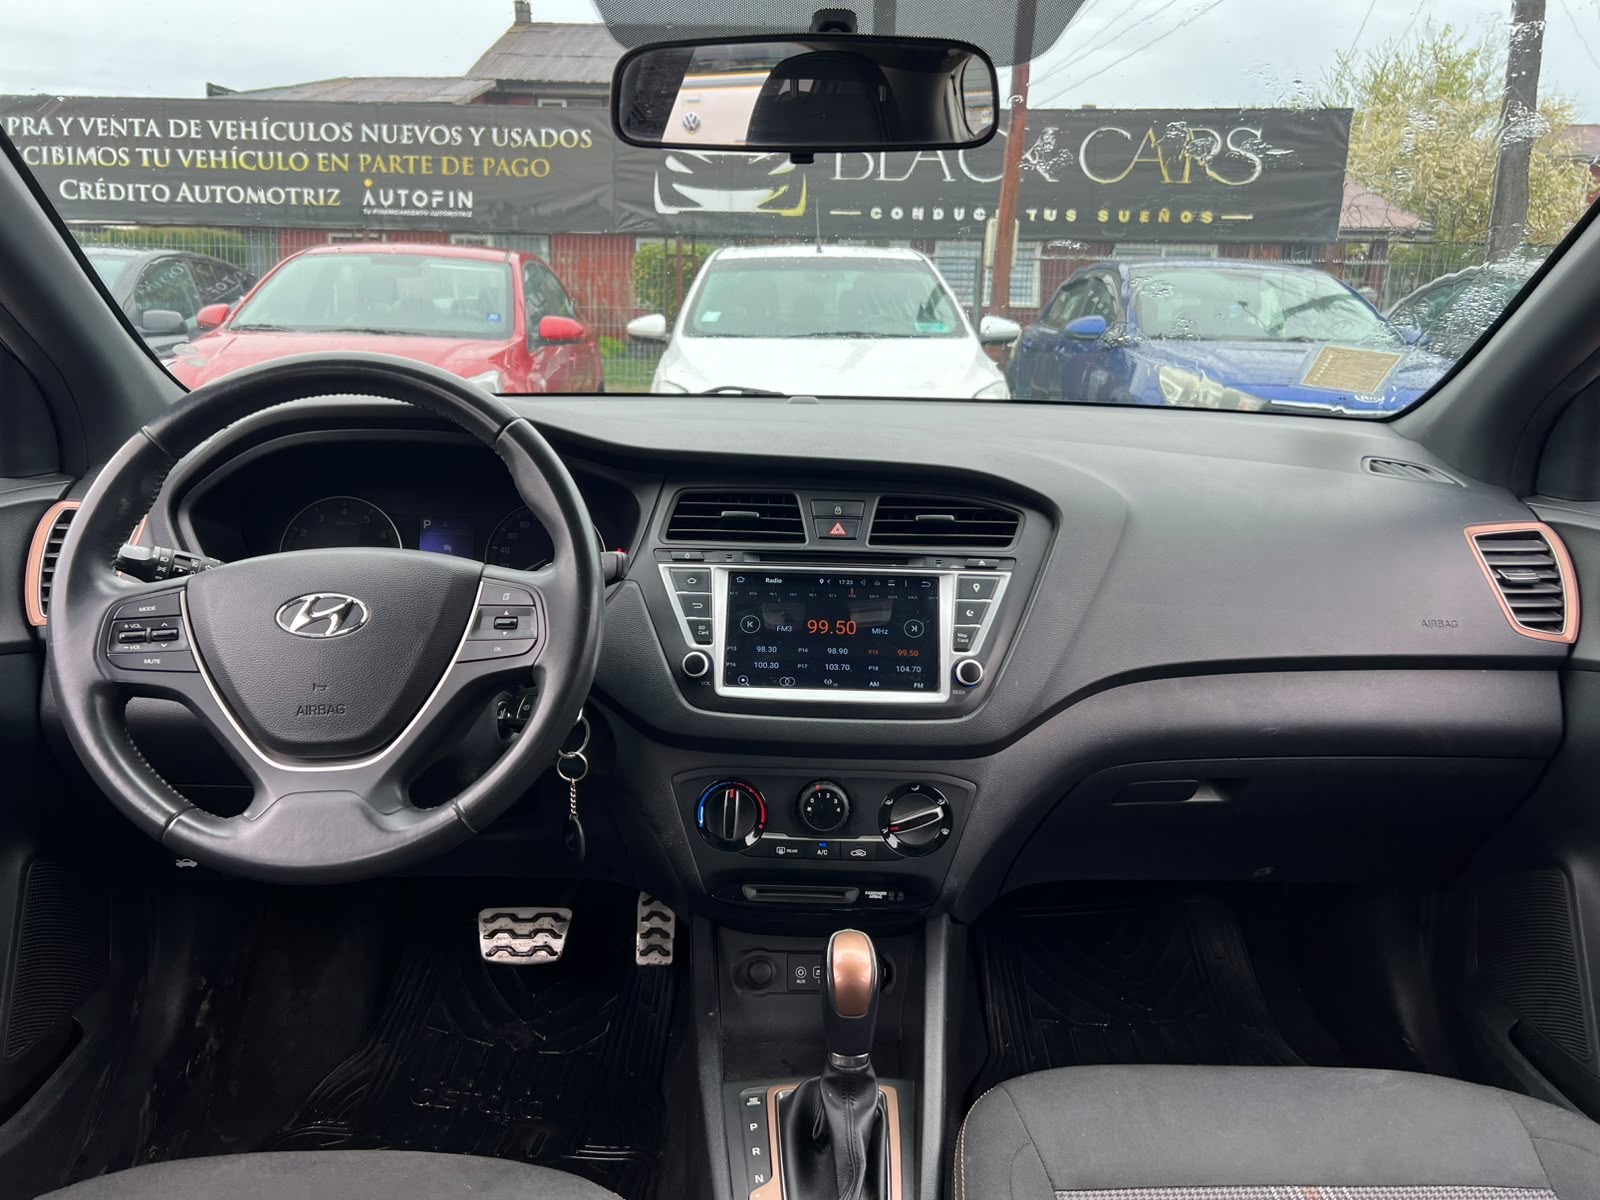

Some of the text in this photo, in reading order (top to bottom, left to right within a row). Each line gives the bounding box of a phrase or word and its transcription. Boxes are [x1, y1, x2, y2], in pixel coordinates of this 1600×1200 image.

[6, 116, 593, 149] PRA Y VENTA DE VEHÍCULOS NUEVOS Y USADOS
[1078, 127, 1263, 185] CARS
[16, 145, 552, 179] CIBIMOS TU VEHÍCULO EN PARTE DE PAGO
[362, 188, 473, 209] AUTOFIN
[870, 207, 1213, 224] CONDUC TUS SUEÑOS
[423, 519, 432, 529] P
[807, 619, 857, 635] 99.50
[1421, 619, 1459, 628] AIRBAG
[756, 645, 778, 653] 98.30
[827, 647, 849, 655] 98.90
[897, 649, 919, 657] 99.50
[754, 661, 780, 669] 100.30
[825, 663, 851, 671] 103.70
[896, 665, 922, 673] 104.70
[295, 704, 347, 717] AIRBAG
[749, 1123, 758, 1131] P
[752, 1147, 761, 1156] R
[755, 1174, 764, 1183] N
